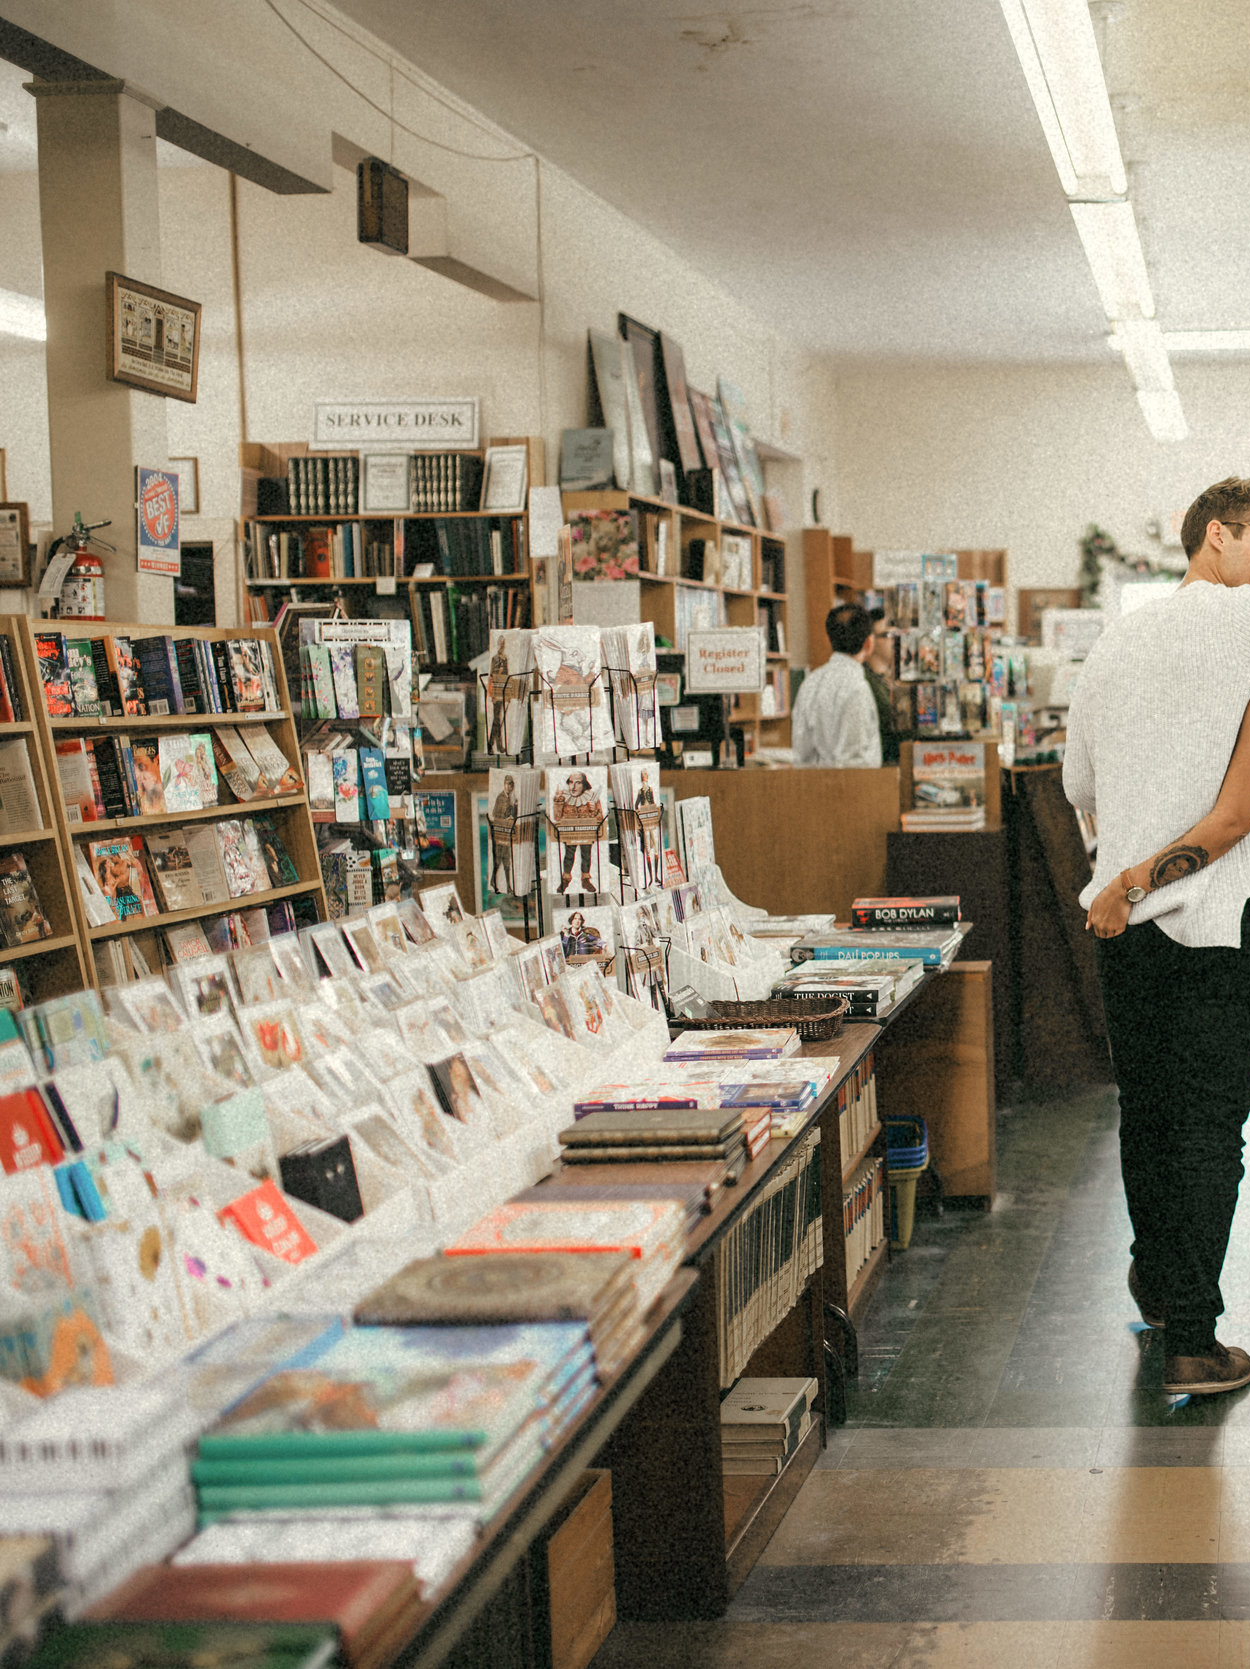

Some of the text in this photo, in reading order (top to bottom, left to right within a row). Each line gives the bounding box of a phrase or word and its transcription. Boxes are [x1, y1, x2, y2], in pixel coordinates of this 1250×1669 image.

[326, 413, 463, 427] SERVICE DESK
[145, 492, 171, 520] BEST
[155, 514, 171, 536] OF
[699, 649, 750, 660] Register
[704, 663, 745, 673] Closed
[923, 750, 976, 767] Harry Potter
[2, 878, 14, 886] THE
[3, 886, 18, 895] LAST
[5, 894, 26, 905] TARGET
[875, 908, 934, 919] BOB DYLAN
[636, 1102, 659, 1110] HAPPY
